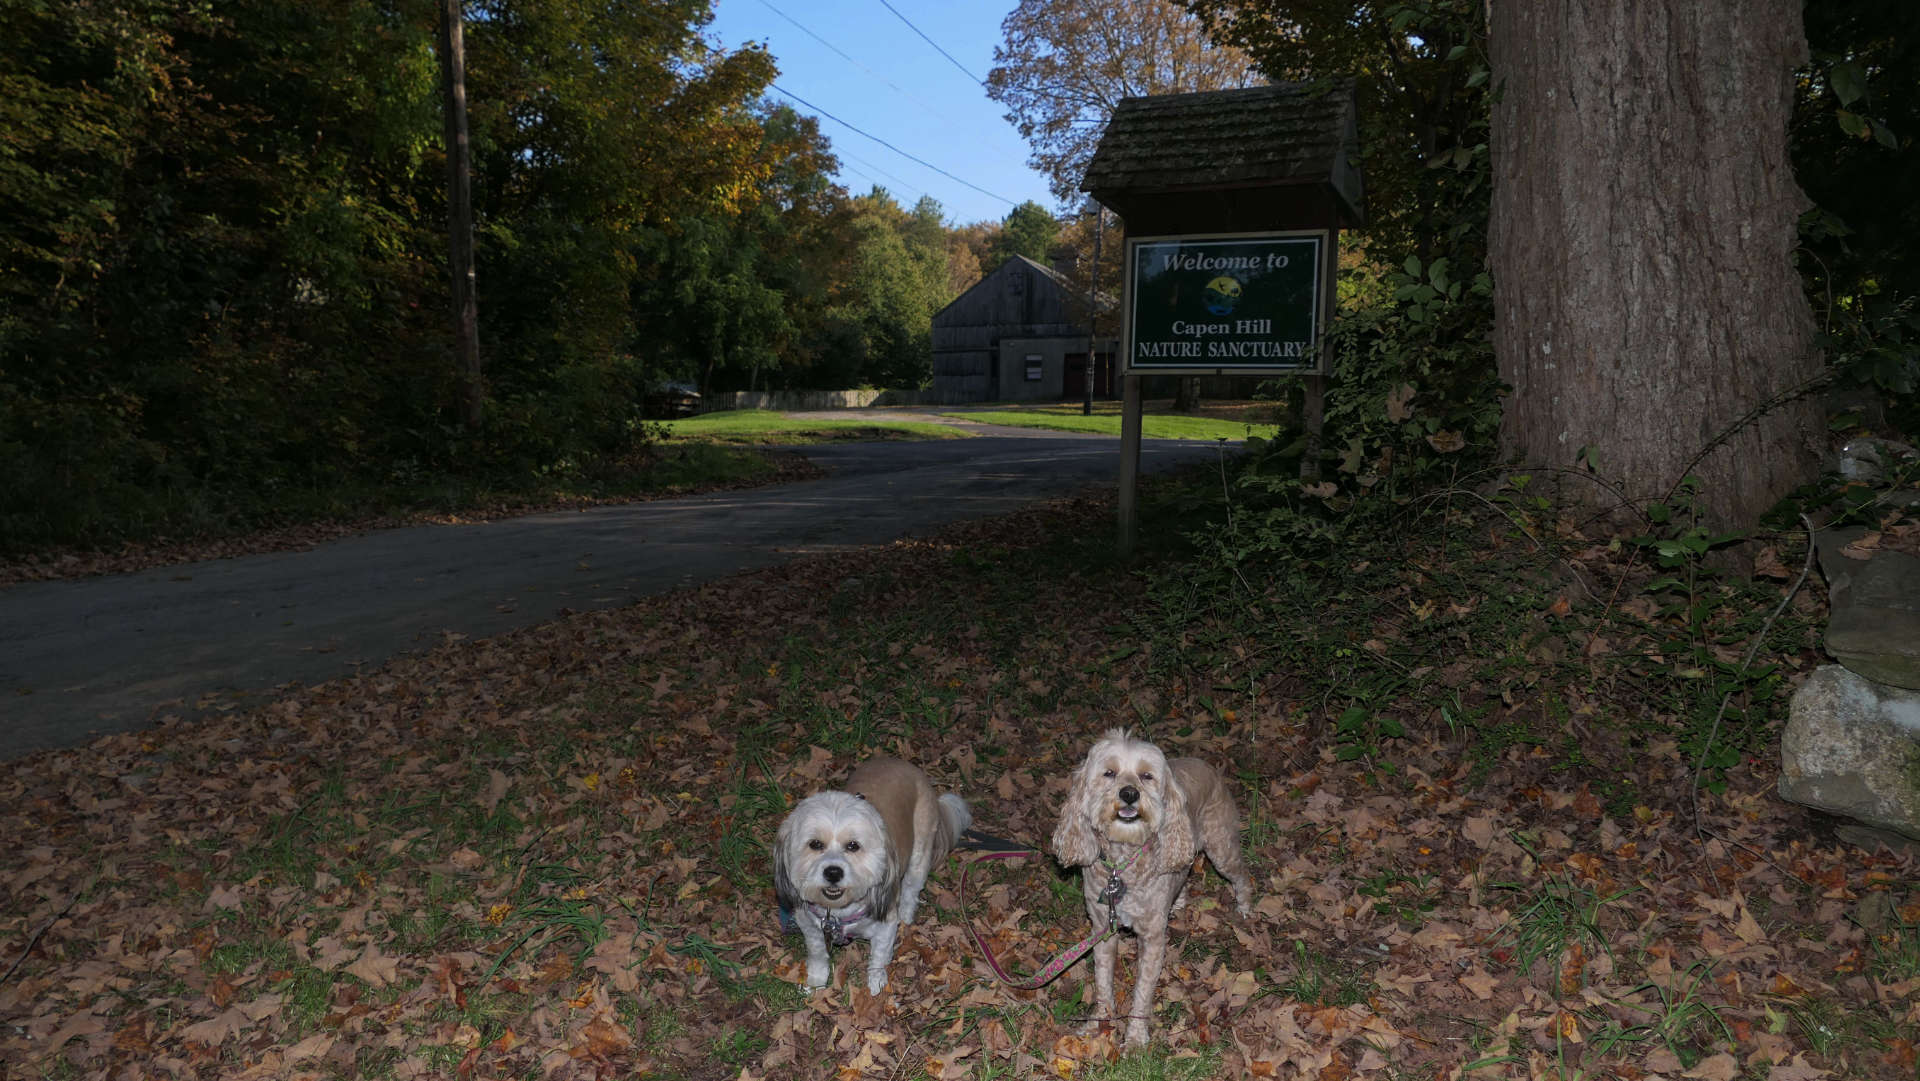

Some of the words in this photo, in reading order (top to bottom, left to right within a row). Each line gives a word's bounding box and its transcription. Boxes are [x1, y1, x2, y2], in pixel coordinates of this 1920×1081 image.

[1163, 253, 1261, 271] Welcome
[1267, 253, 1289, 268] to
[1172, 321, 1230, 337] Capen
[1236, 320, 1272, 334] Hill
[1139, 342, 1202, 357] NATURE
[1208, 341, 1307, 357] SANCTUARY
